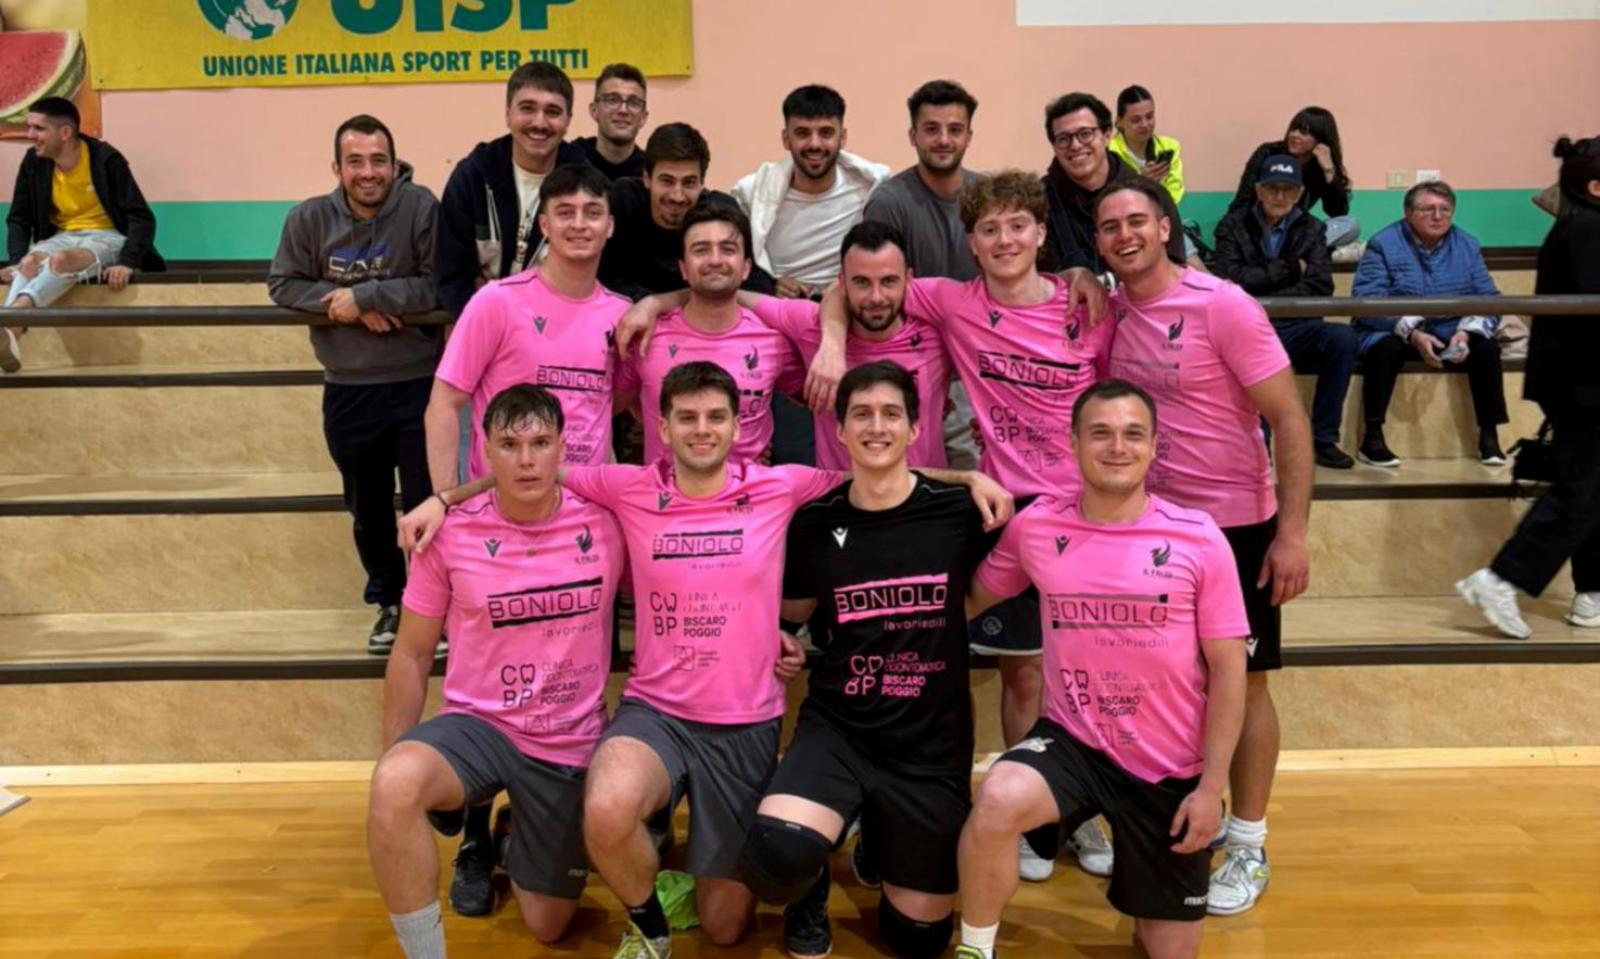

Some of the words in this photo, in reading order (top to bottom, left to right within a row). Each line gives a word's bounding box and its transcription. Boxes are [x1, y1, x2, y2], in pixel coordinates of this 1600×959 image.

[203, 55, 287, 77] UNIONE
[296, 52, 395, 75] ITALIANA
[403, 50, 472, 73] SPORT
[481, 50, 521, 71] PER
[530, 48, 588, 69] TUTTI
[979, 355, 1078, 386] BONIOLO
[652, 536, 744, 554] BONIOLO
[488, 587, 602, 620] BONIOLO
[835, 585, 947, 613] BONIOLO
[683, 616, 727, 626] BISCARO
[1048, 600, 1168, 624] BONIOLO
[654, 616, 677, 636] BP
[683, 627, 721, 637] POGGIO
[883, 674, 926, 686] BISCARO
[503, 689, 533, 708] BP
[540, 692, 576, 705] POGGIO
[881, 686, 920, 697] POGGIO
